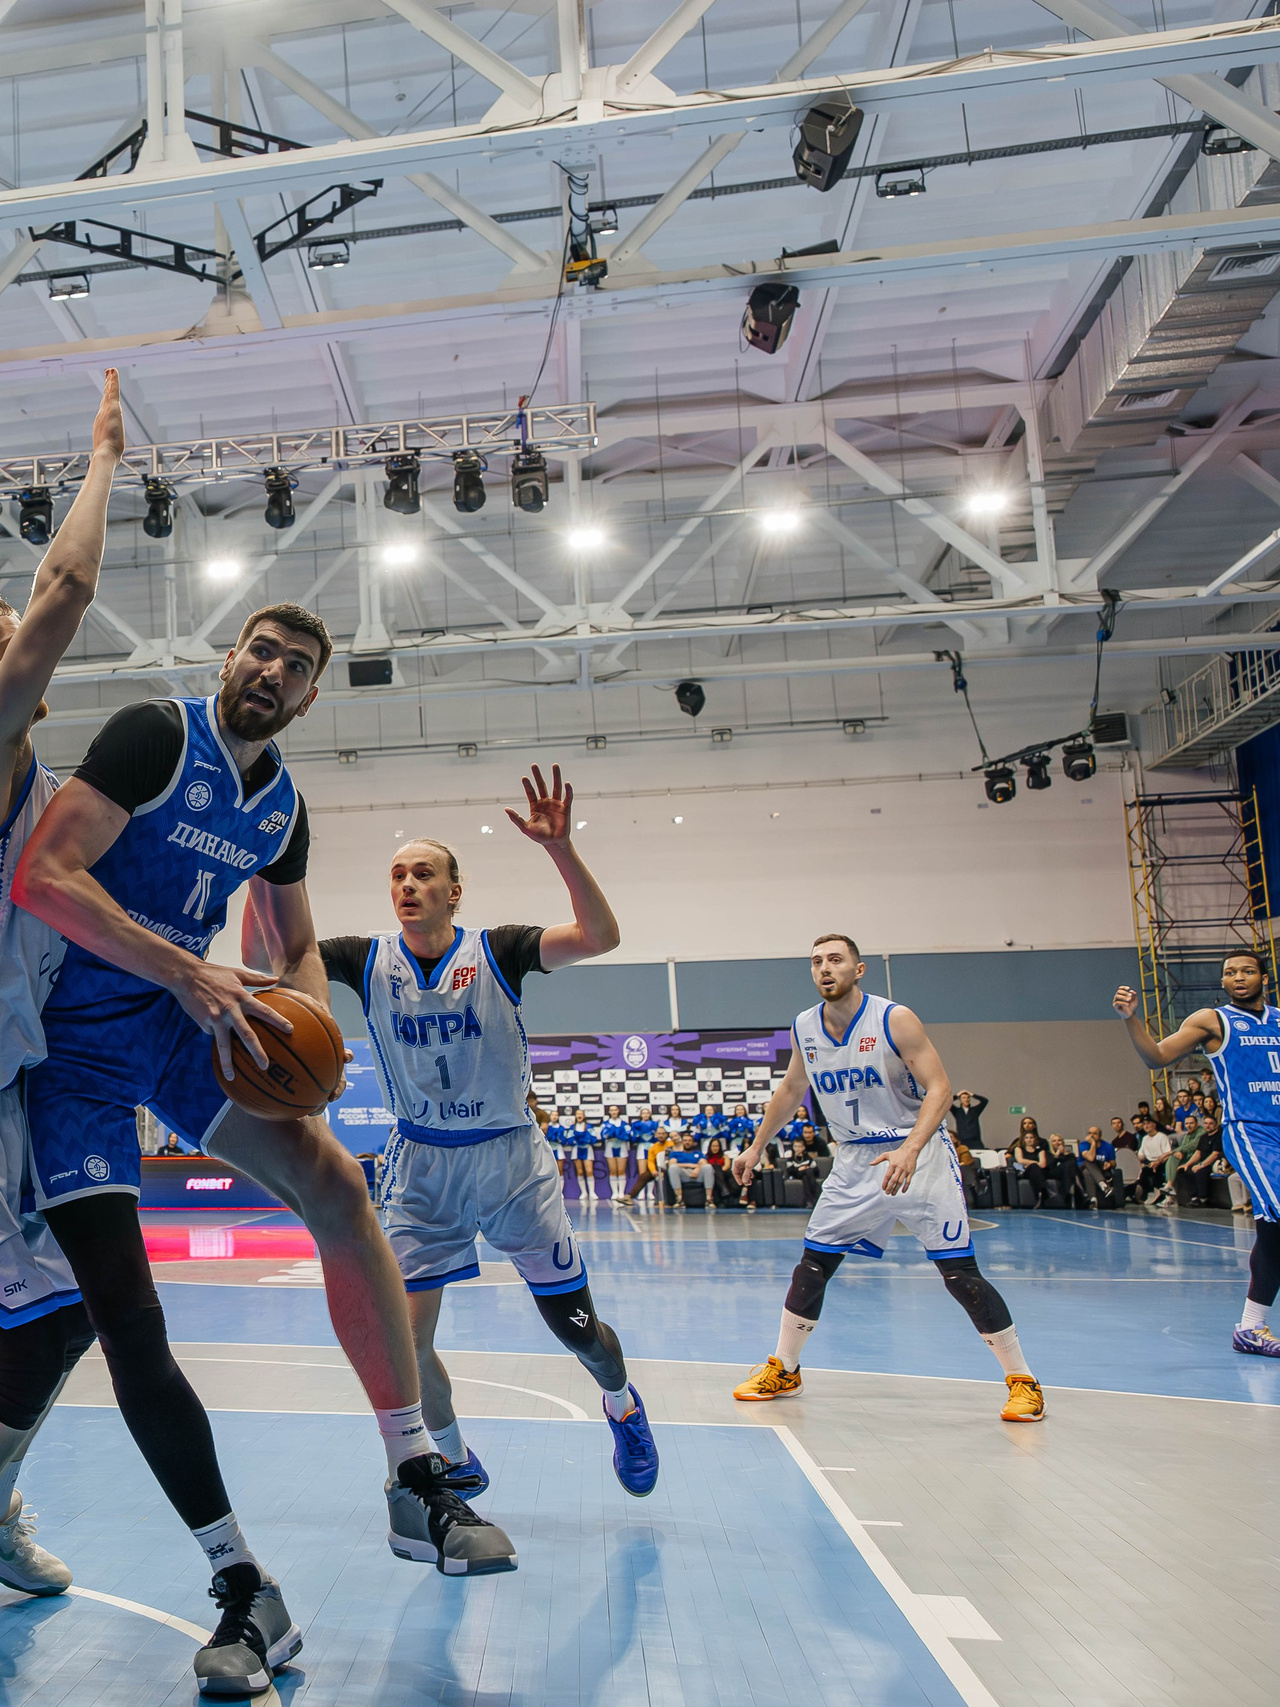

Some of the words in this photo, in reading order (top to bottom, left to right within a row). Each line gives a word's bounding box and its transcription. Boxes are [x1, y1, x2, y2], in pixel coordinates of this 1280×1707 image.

[258, 819, 283, 836] BET
[166, 821, 258, 870] ДИНАМО
[182, 869, 217, 921] 10
[453, 965, 476, 980] FON
[452, 974, 475, 991] BET
[389, 1003, 483, 1049] ЮГРА
[859, 1044, 876, 1053] BET
[860, 1036, 877, 1045] FON
[434, 1054, 452, 1090] 1
[811, 1065, 886, 1096] ЮГРА
[845, 1098, 860, 1127] 7
[185, 1178, 234, 1191] FONBET
[3, 1278, 29, 1297] STK
[796, 1323, 814, 1332] 23
